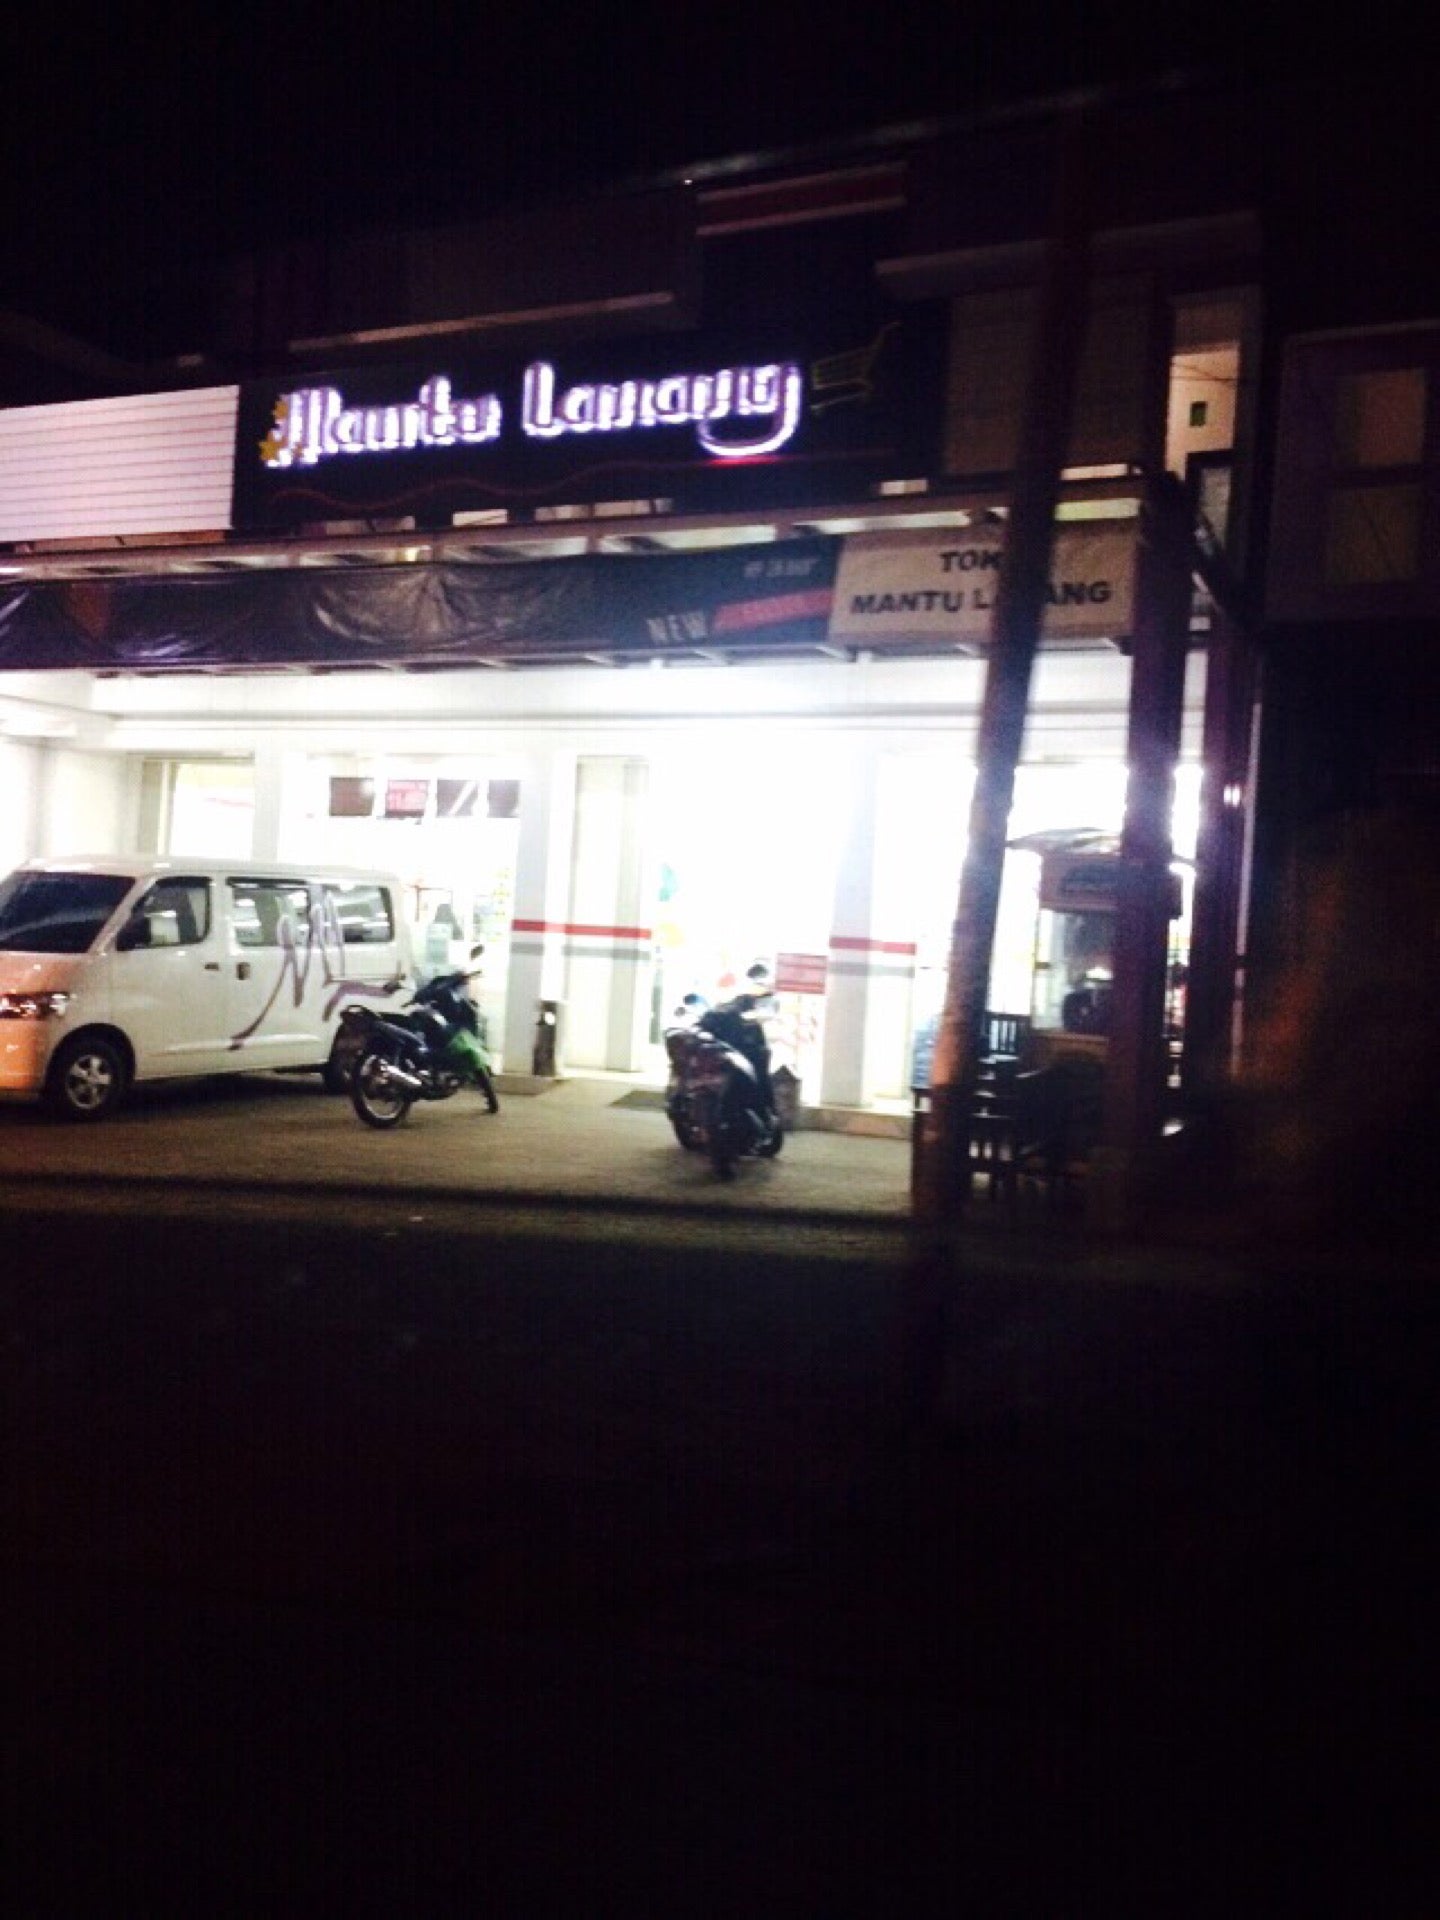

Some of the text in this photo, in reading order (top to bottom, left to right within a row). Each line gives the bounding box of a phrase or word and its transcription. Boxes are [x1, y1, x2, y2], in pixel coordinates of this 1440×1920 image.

[521, 360, 803, 457] Lanang
[940, 550, 1006, 573] TOK
[850, 591, 964, 614] MANTU
[972, 580, 1112, 611] LANG
[646, 610, 708, 645] NEW
